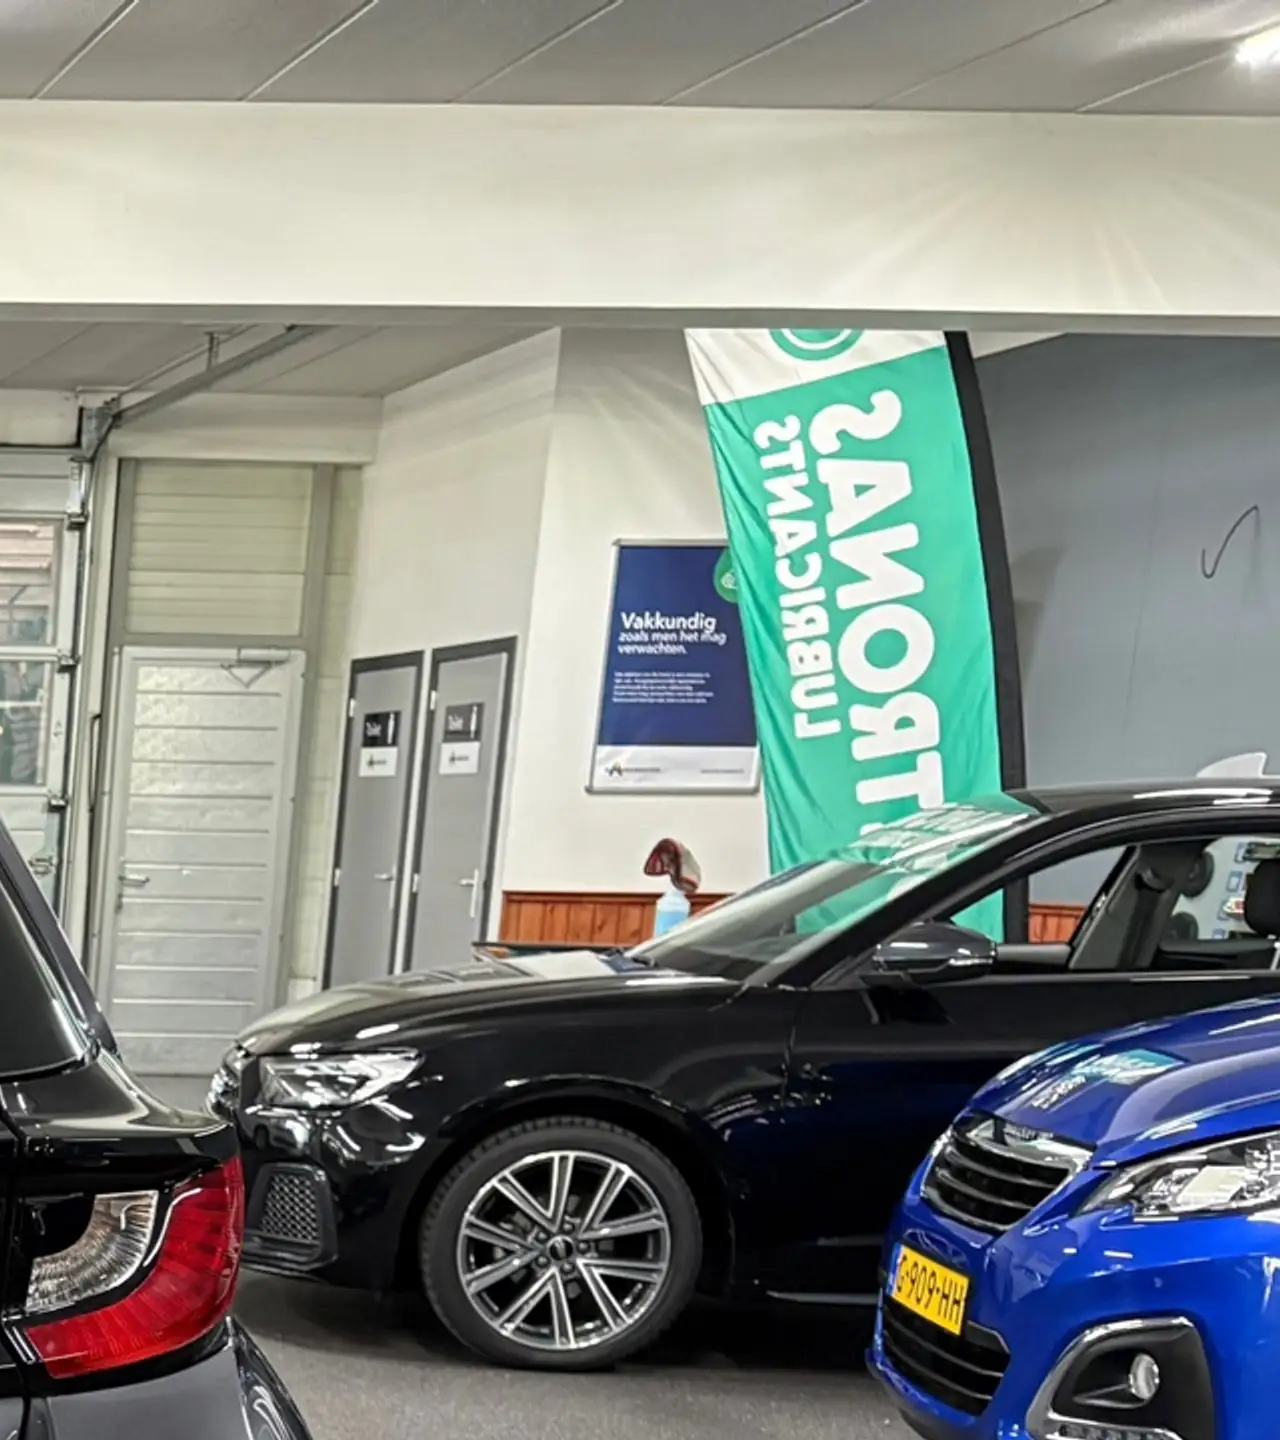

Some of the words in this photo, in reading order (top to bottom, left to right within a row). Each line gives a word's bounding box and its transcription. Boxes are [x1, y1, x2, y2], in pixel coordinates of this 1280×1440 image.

[620, 611, 717, 633] Vakkundig
[618, 631, 649, 642] zoals
[651, 632, 677, 642] men
[679, 631, 699, 643] het
[700, 632, 727, 646] mag
[617, 644, 688, 654] verwachten.
